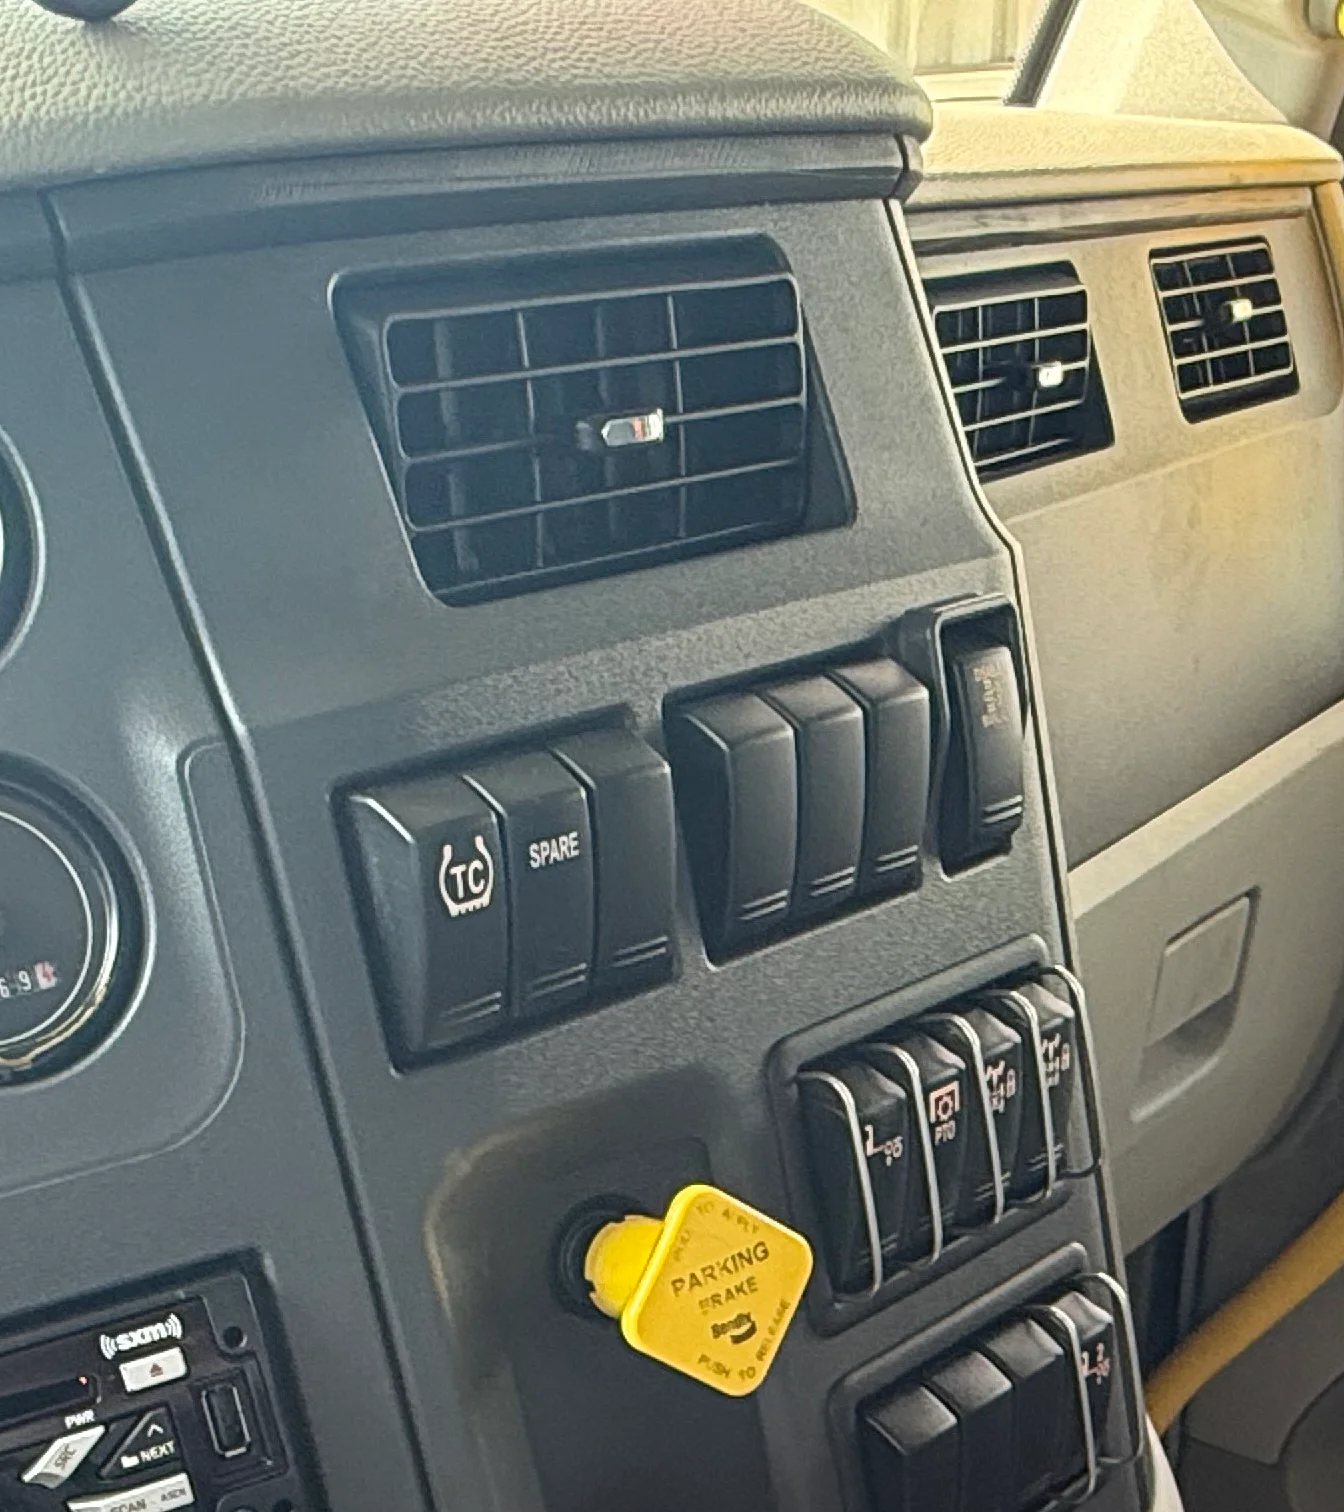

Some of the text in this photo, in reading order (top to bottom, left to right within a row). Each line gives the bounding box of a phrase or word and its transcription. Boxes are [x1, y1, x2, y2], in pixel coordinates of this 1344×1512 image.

[529, 831, 580, 870] SPARE
[450, 859, 487, 900] TC
[671, 1241, 770, 1298] PARKING
[139, 1440, 176, 1463] NEXT
